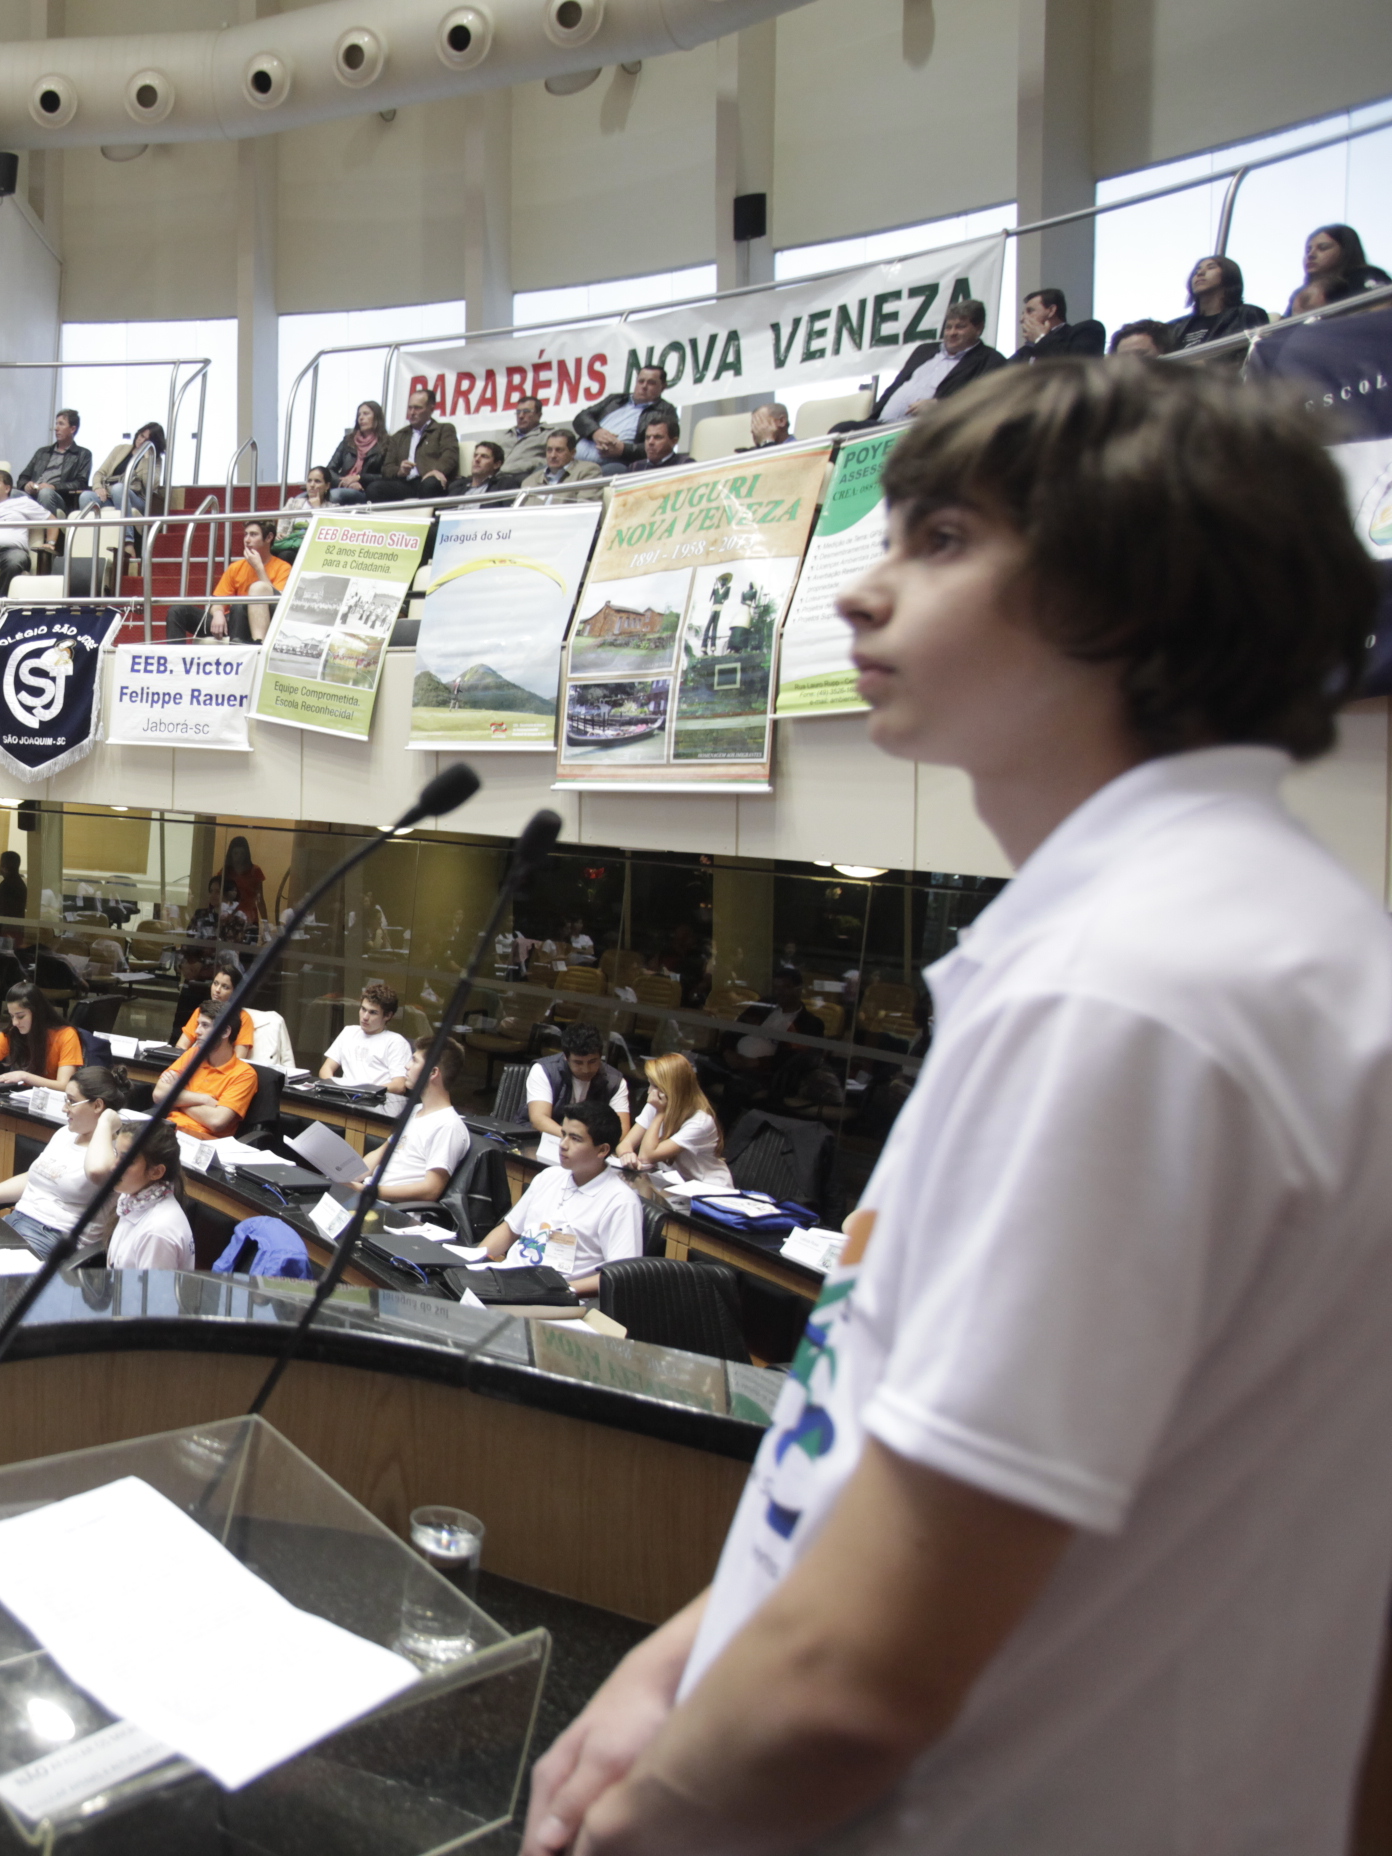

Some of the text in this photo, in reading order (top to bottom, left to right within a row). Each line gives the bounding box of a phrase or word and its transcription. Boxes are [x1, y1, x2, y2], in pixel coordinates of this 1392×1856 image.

[407, 349, 609, 421] PARABÉNS
[624, 329, 743, 393] NOVA
[843, 438, 897, 469] POYE
[839, 463, 883, 484] ASSESS
[651, 473, 763, 518] AUGURI
[607, 497, 802, 551] NOVA VENEZA
[317, 527, 419, 549] EEB Bertino Silva
[438, 529, 512, 545] Jaraguá do Sul
[325, 545, 398, 562] 82 anos Educando
[629, 551, 661, 569] 1891
[671, 540, 707, 561] 1958
[322, 558, 341, 568] para
[349, 560, 392, 574] Cidadania.
[805, 593, 835, 603] Loteament
[52, 624, 77, 635] SÃO
[130, 655, 243, 676] EEB. Victor
[119, 686, 183, 709] Felippe
[274, 681, 360, 707] Equipe Comprometida.
[274, 695, 354, 721] Escola Reconhecida!
[142, 717, 210, 735] Jaborá-sc
[2, 734, 18, 744] SÃO
